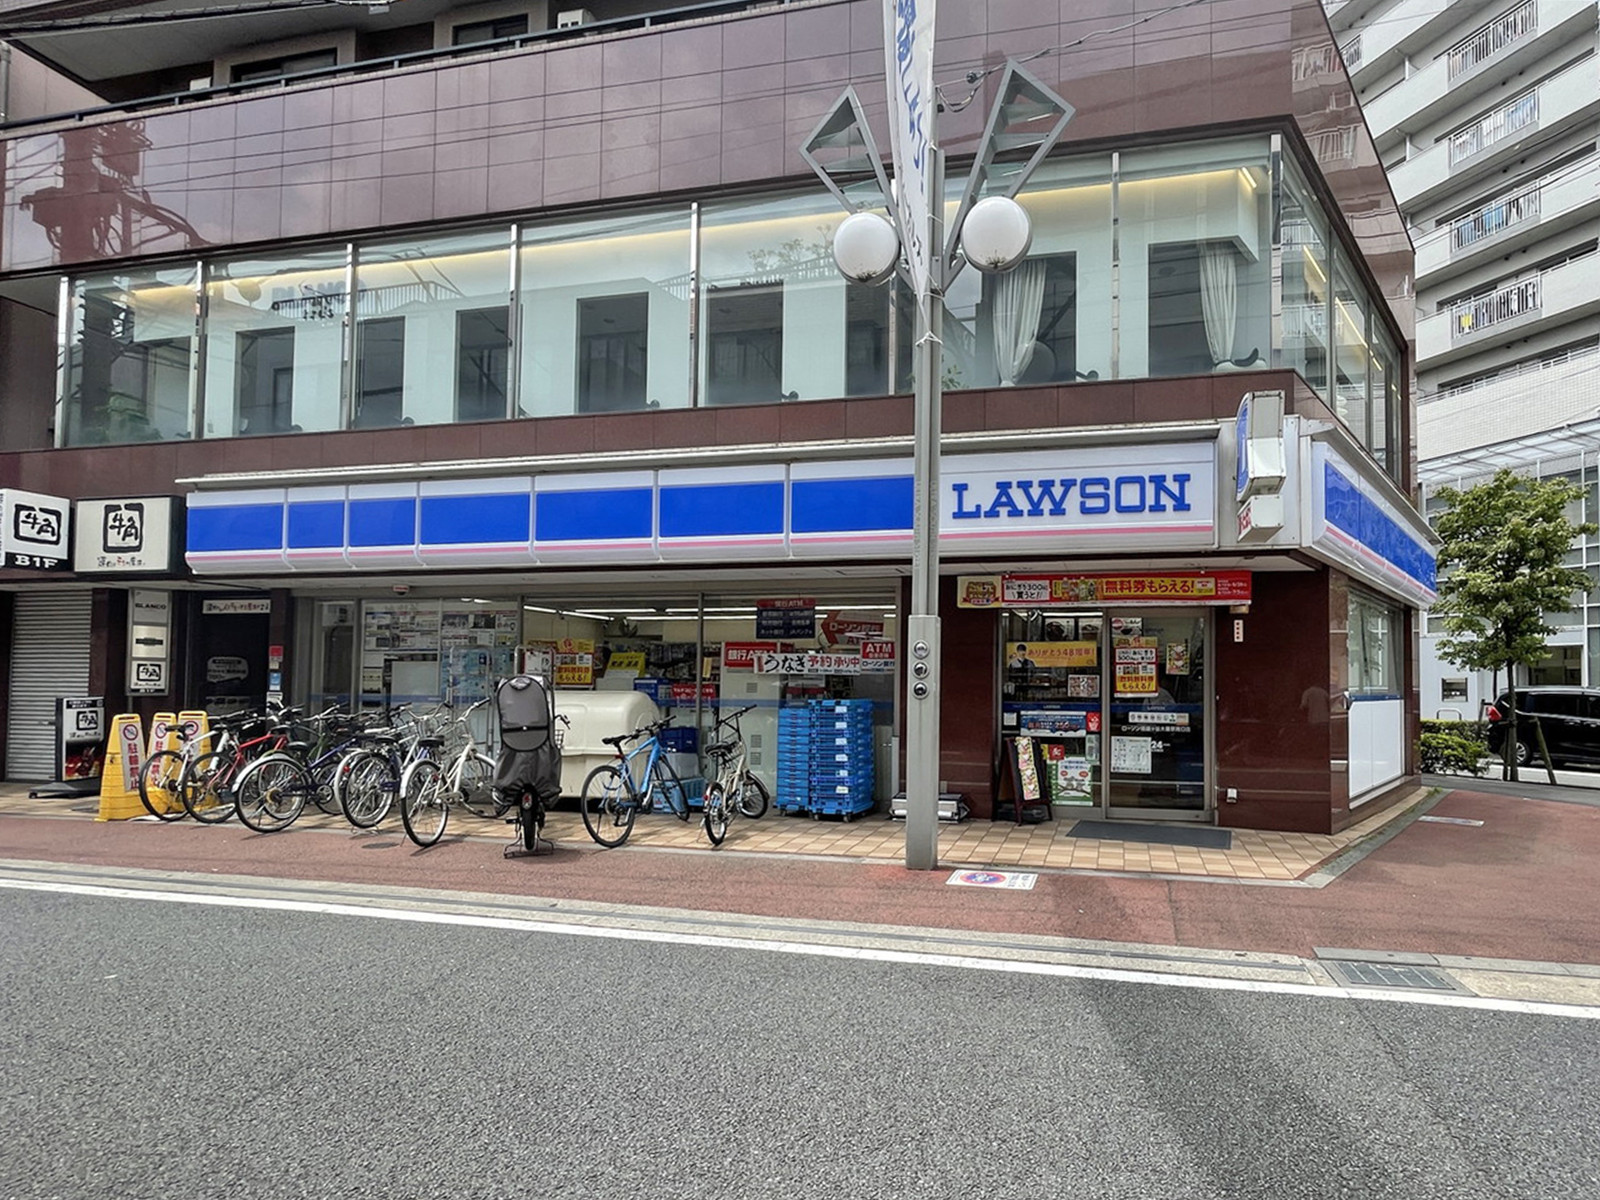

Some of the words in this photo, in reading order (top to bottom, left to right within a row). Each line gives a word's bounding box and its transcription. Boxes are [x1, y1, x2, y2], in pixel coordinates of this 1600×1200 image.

[952, 473, 1191, 519] LAWSON
[21, 512, 57, 537] 牛角
[109, 513, 139, 541] 牛角
[15, 554, 58, 569] B1F
[1105, 580, 1195, 594] 無料券もらえる!
[135, 602, 167, 610] BLANCO
[866, 643, 892, 653] ATM
